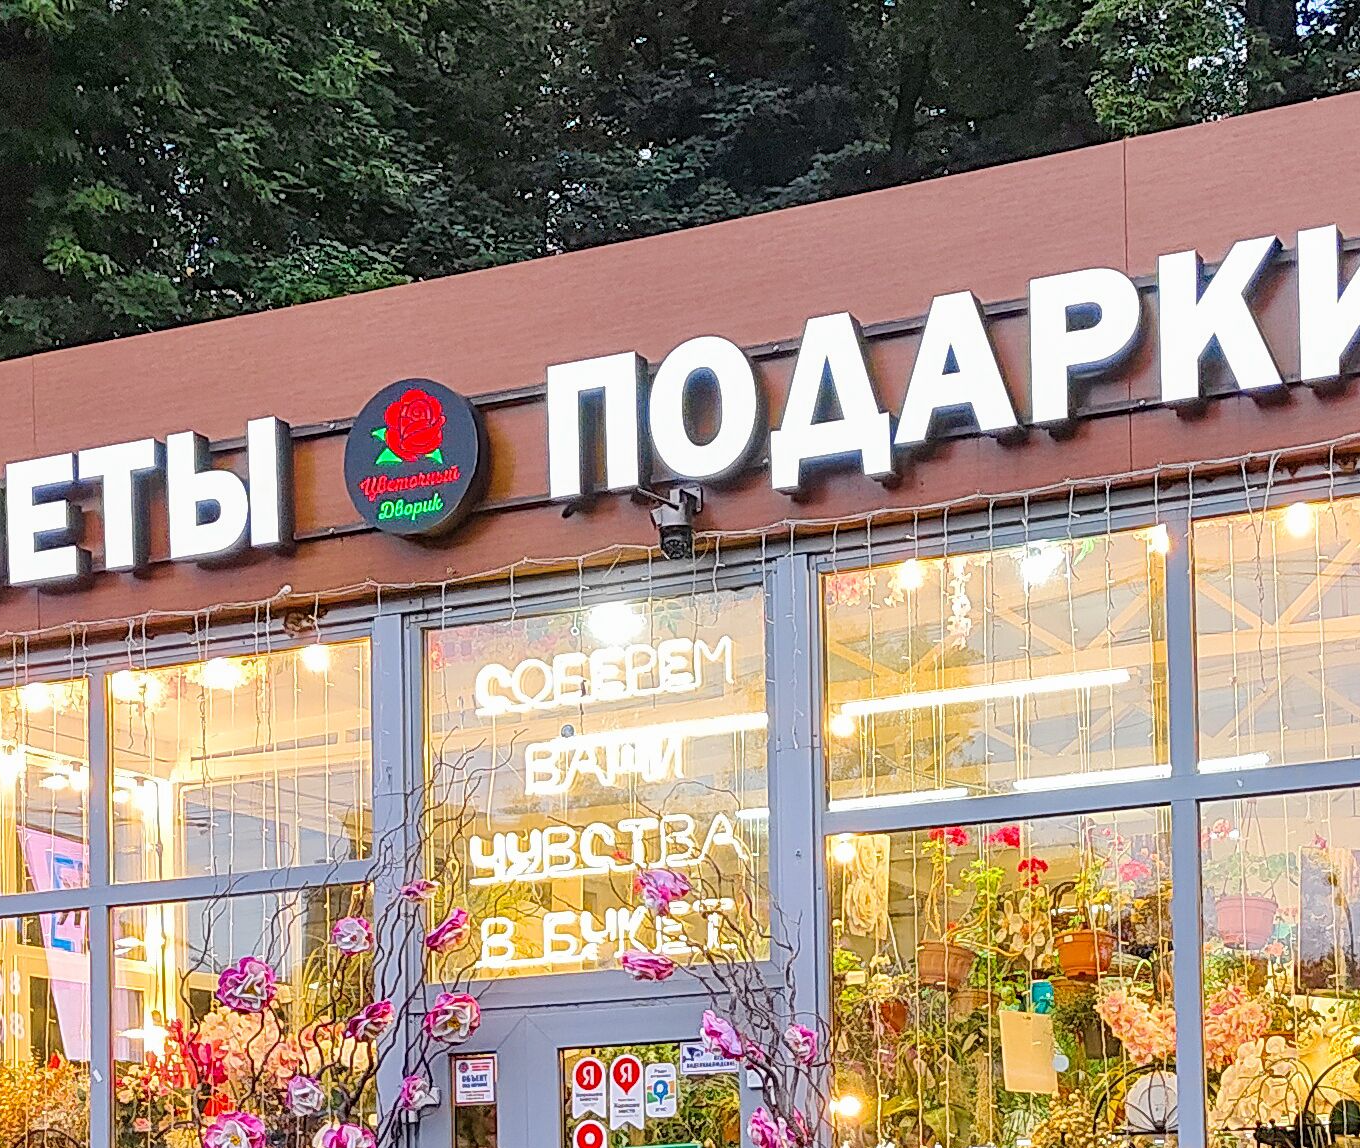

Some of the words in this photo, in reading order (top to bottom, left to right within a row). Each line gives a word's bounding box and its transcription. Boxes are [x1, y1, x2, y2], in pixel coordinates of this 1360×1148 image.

[358, 465, 461, 503] Цветочный
[378, 492, 444, 522] Дворик
[469, 813, 747, 885] ЧУВСТВА
[479, 916, 516, 966] В
